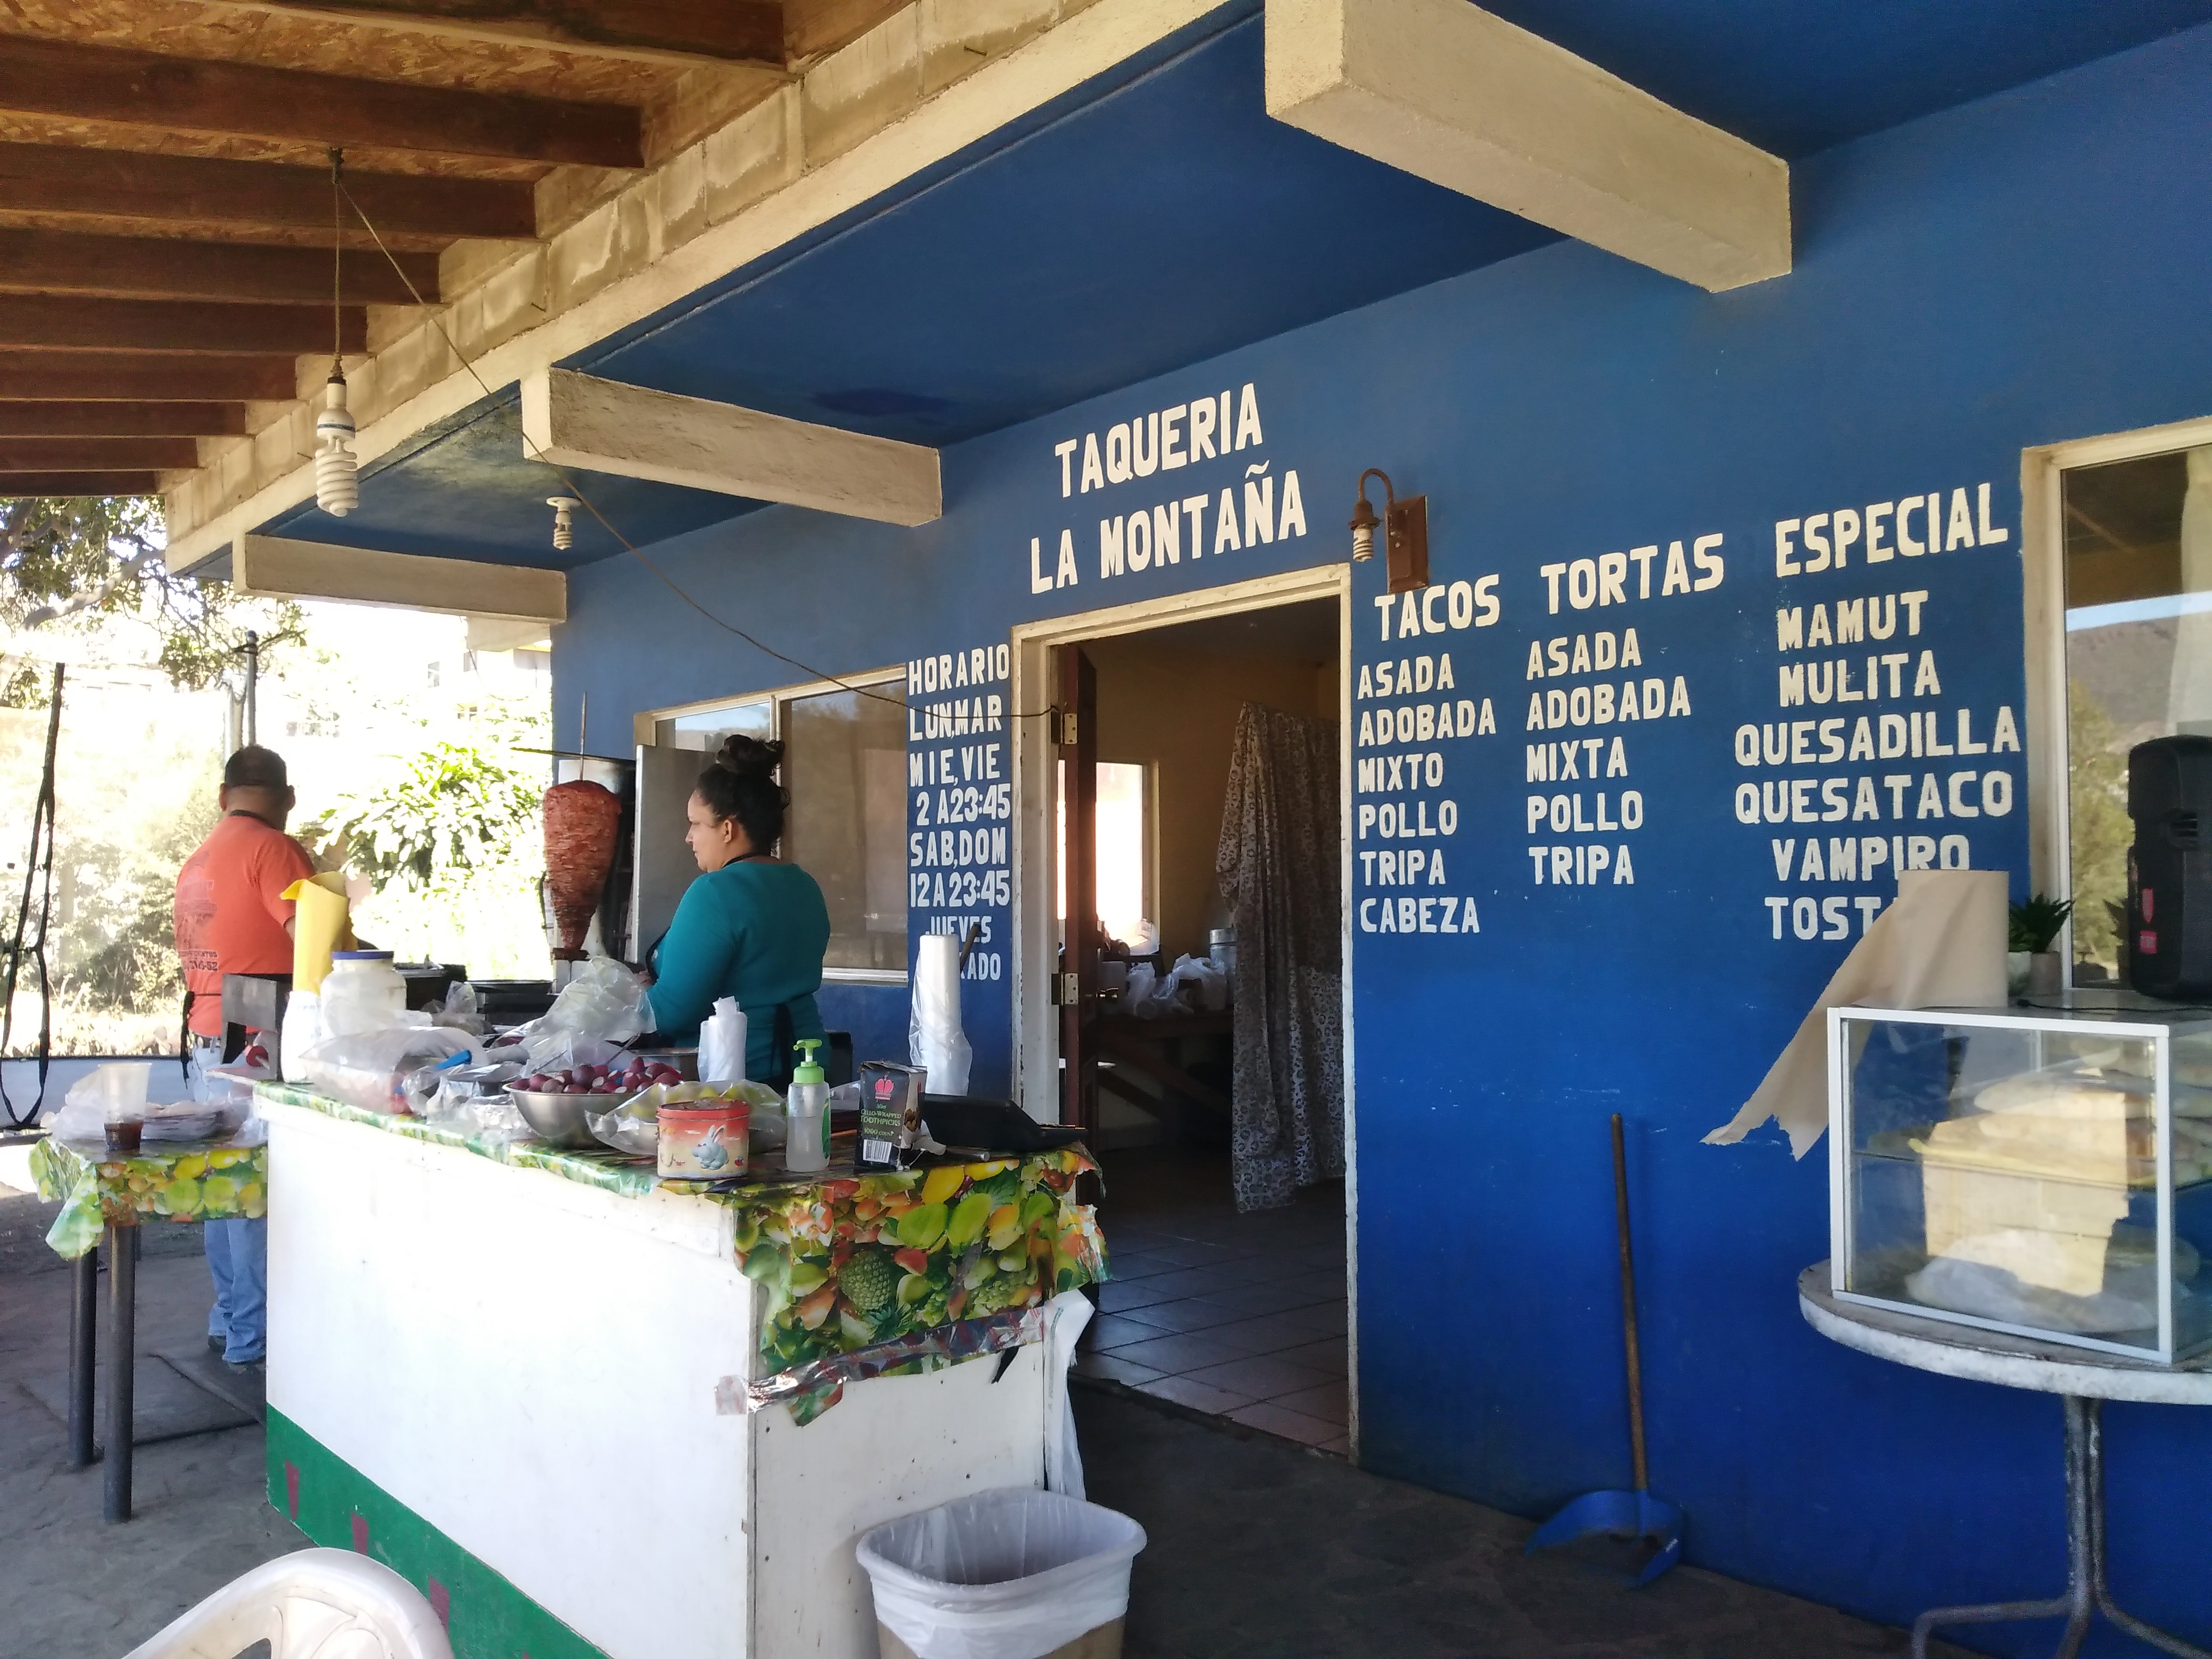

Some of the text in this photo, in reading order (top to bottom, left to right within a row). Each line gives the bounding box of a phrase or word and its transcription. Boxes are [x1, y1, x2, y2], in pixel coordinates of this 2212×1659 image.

[1055, 383, 1263, 498] TAQUERIA
[1031, 459, 1307, 594] LA MONTAÑA
[1775, 482, 2008, 578] ESPECIAL
[1540, 532, 1724, 615] TORTAS
[1374, 574, 1500, 641] TACOS
[1778, 590, 1928, 651] MAMUT
[909, 643, 1010, 696] HORARIO
[1357, 653, 1455, 700] ASADA
[1526, 628, 1642, 681] ASADA
[1779, 649, 1941, 707] MULITA
[1358, 698, 1497, 747] ADOBADA
[1526, 675, 1691, 731] ADOBADA
[1527, 736, 1628, 782] MIXTA
[1735, 706, 2021, 766] QUESADILLA
[1358, 752, 1443, 793] MIXTO
[1735, 770, 2012, 824] QUESATACO
[1359, 800, 1457, 840] POLLO
[1527, 791, 1643, 834] POLLO
[1359, 849, 1446, 886] TRIPA
[1528, 844, 1634, 885] TRIPA
[1360, 897, 1480, 933] CABEZA
[1765, 897, 1899, 940] TOST
[860, 1115, 901, 1126] TOOTHPICKS
